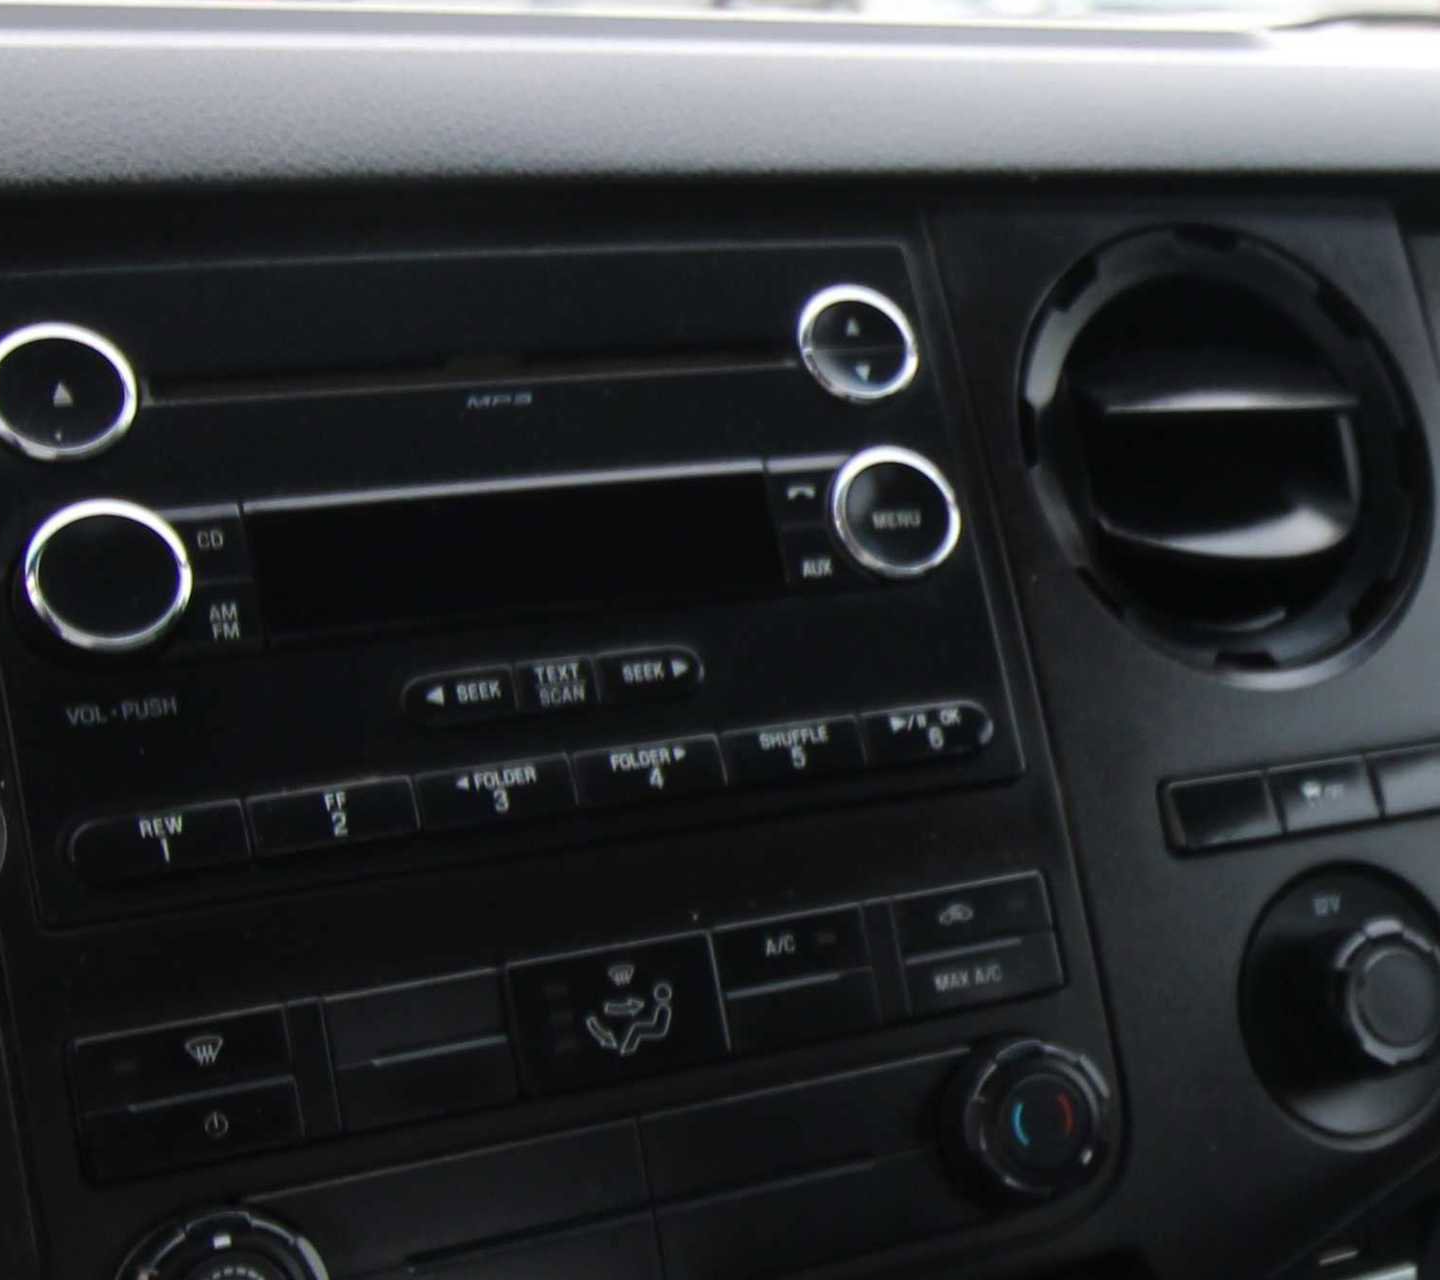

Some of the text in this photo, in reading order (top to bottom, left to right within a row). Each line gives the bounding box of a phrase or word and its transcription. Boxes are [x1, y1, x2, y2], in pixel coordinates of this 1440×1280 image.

[465, 392, 533, 409] MP3
[872, 510, 922, 530] MENU
[196, 529, 224, 549] CD
[802, 558, 833, 579] AUX
[209, 602, 238, 623] AM
[212, 622, 241, 641] FM
[532, 663, 580, 685] TEXT
[621, 660, 665, 684] SEEK
[455, 680, 503, 704] SEEK
[539, 684, 586, 707] SCAN
[121, 696, 178, 720] PUSH
[939, 709, 962, 727] OK
[759, 724, 830, 751] SHUFFLE
[927, 727, 945, 751] 6
[609, 748, 671, 772] FOLDER
[791, 746, 807, 770] 5
[473, 765, 538, 790] FOLDER
[648, 766, 665, 790] 4
[323, 790, 348, 813] FF
[492, 789, 510, 814] 3
[138, 815, 183, 840] REW
[330, 811, 350, 838] 2
[160, 838, 171, 864] 1
[764, 933, 797, 957] A/C
[933, 963, 1003, 993] MAX A/C
